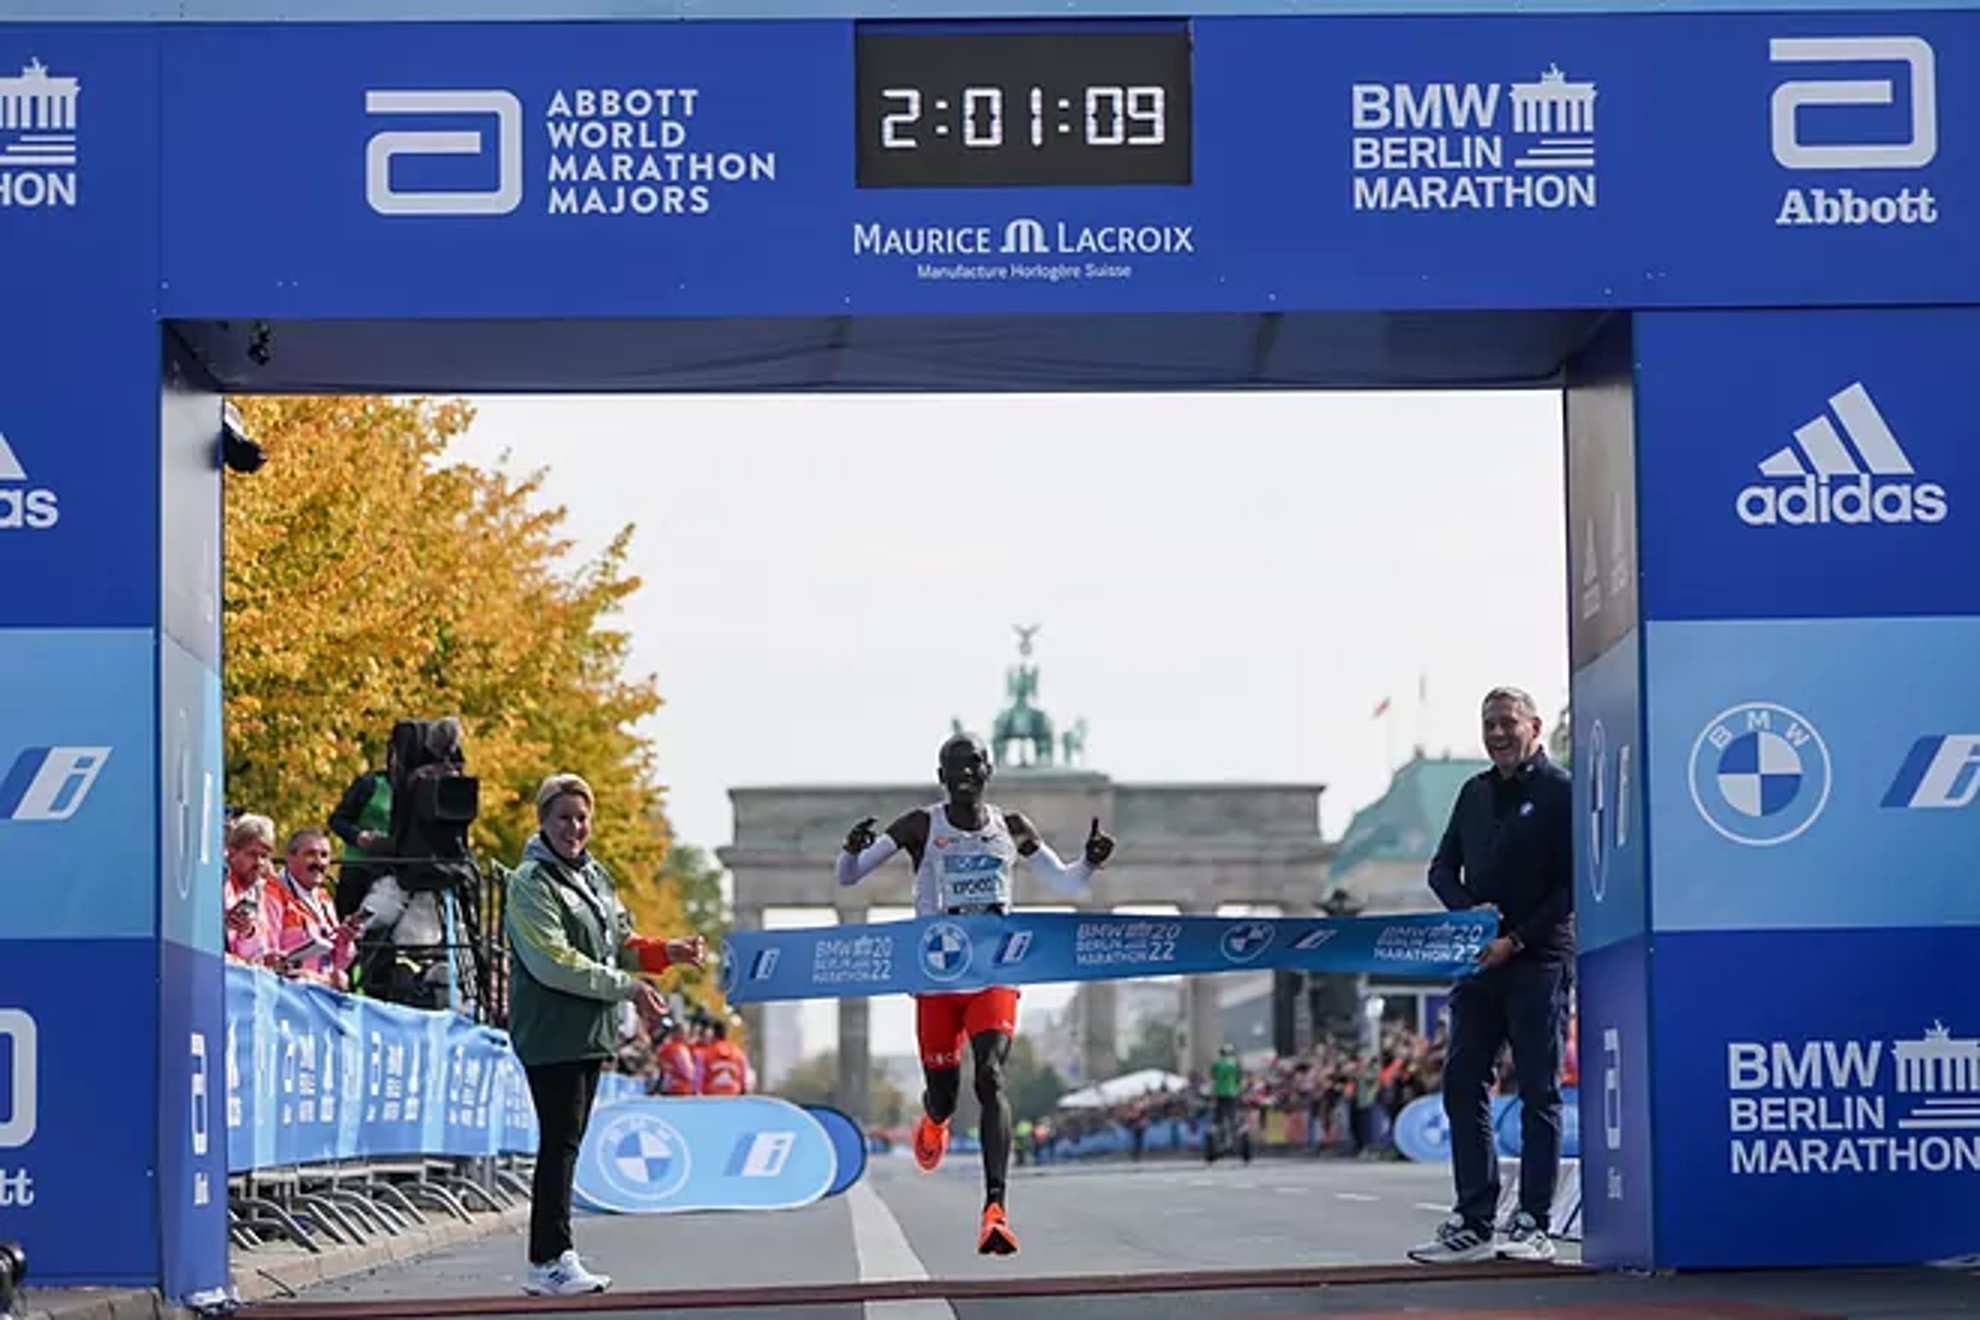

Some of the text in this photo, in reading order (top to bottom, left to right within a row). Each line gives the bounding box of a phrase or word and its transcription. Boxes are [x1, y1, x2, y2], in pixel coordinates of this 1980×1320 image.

[548, 88, 699, 118] ABBOTT
[882, 86, 1165, 148] 2:01:09
[1353, 84, 1501, 129] BMW
[547, 120, 686, 149] WORLD
[548, 152, 775, 182] MARATHON
[1353, 136, 1502, 169] BERLIN
[548, 185, 709, 214] MAJORS
[1353, 174, 1596, 209] MARATHON
[1776, 187, 1938, 224] Abbott
[853, 223, 991, 255] MAURICE
[1057, 221, 1194, 253] LACROIX
[917, 263, 1008, 280] Manufacture
[1084, 262, 1132, 279] Suisse
[1736, 474, 1948, 525] adidas
[1709, 709, 1811, 750] BMW
[1728, 1041, 1882, 1089] BMW
[1730, 1096, 1885, 1132] BERLIN
[1730, 1136, 1980, 1174] MARATHON
